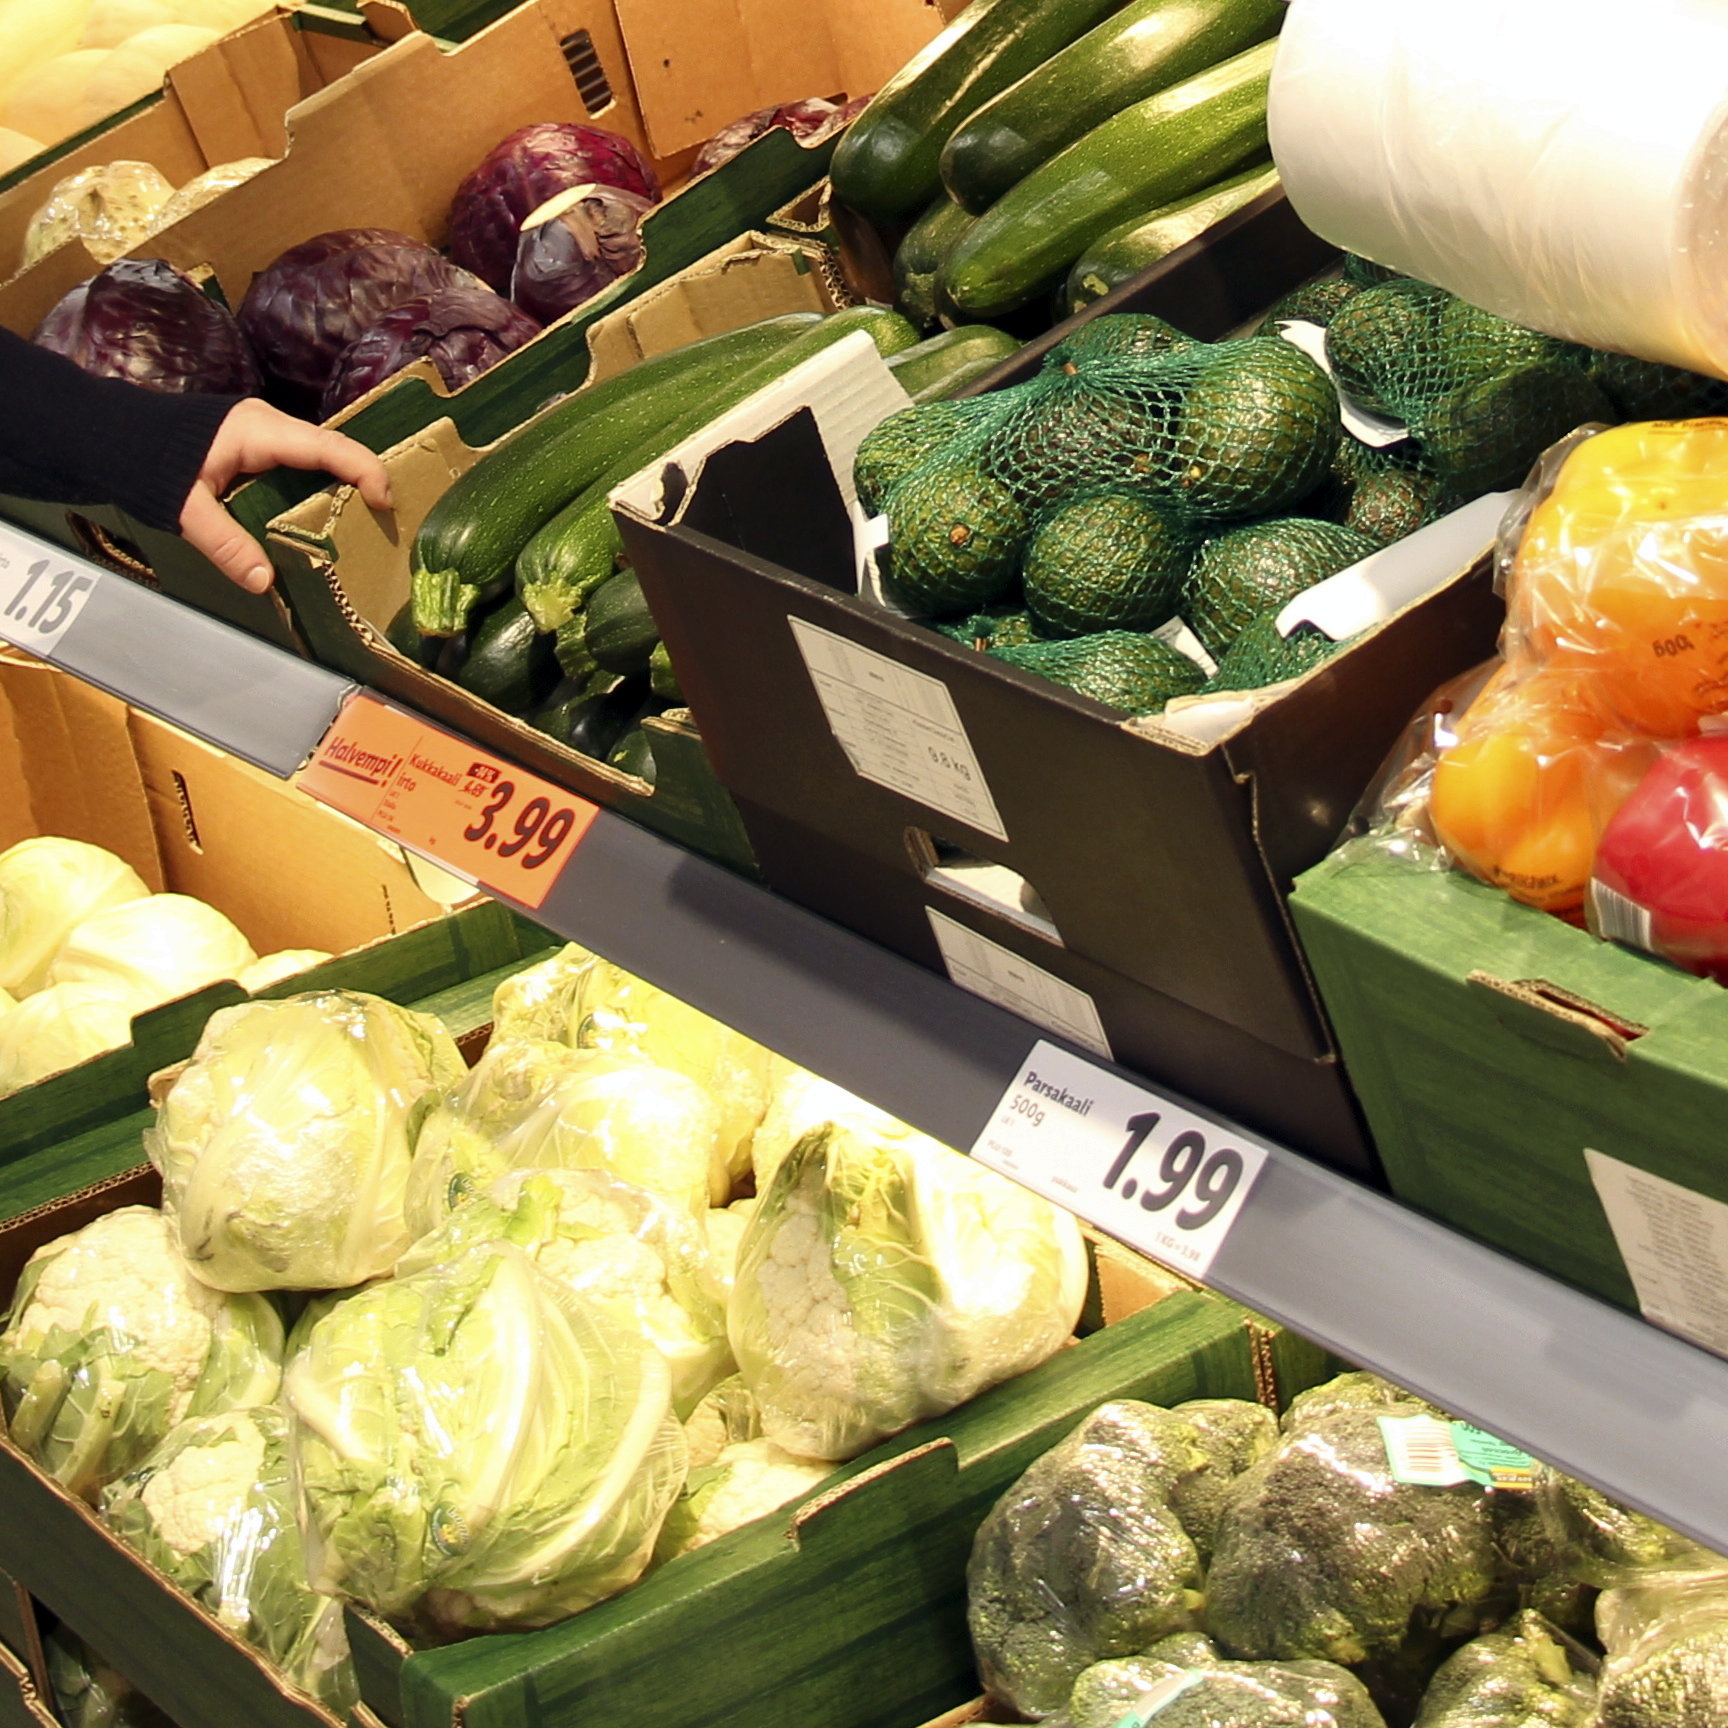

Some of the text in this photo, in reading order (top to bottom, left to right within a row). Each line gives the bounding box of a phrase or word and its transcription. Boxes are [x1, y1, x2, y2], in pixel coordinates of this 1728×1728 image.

[4, 559, 93, 634] 1.15
[324, 736, 403, 788] Halvempi!
[396, 774, 416, 792] irto
[409, 754, 464, 787] Kukkakaali
[464, 781, 576, 870] 3.99
[1009, 1094, 1046, 1127] 500g
[1024, 1071, 1094, 1116] Parsakaali
[1103, 1112, 1244, 1231] 1.99
